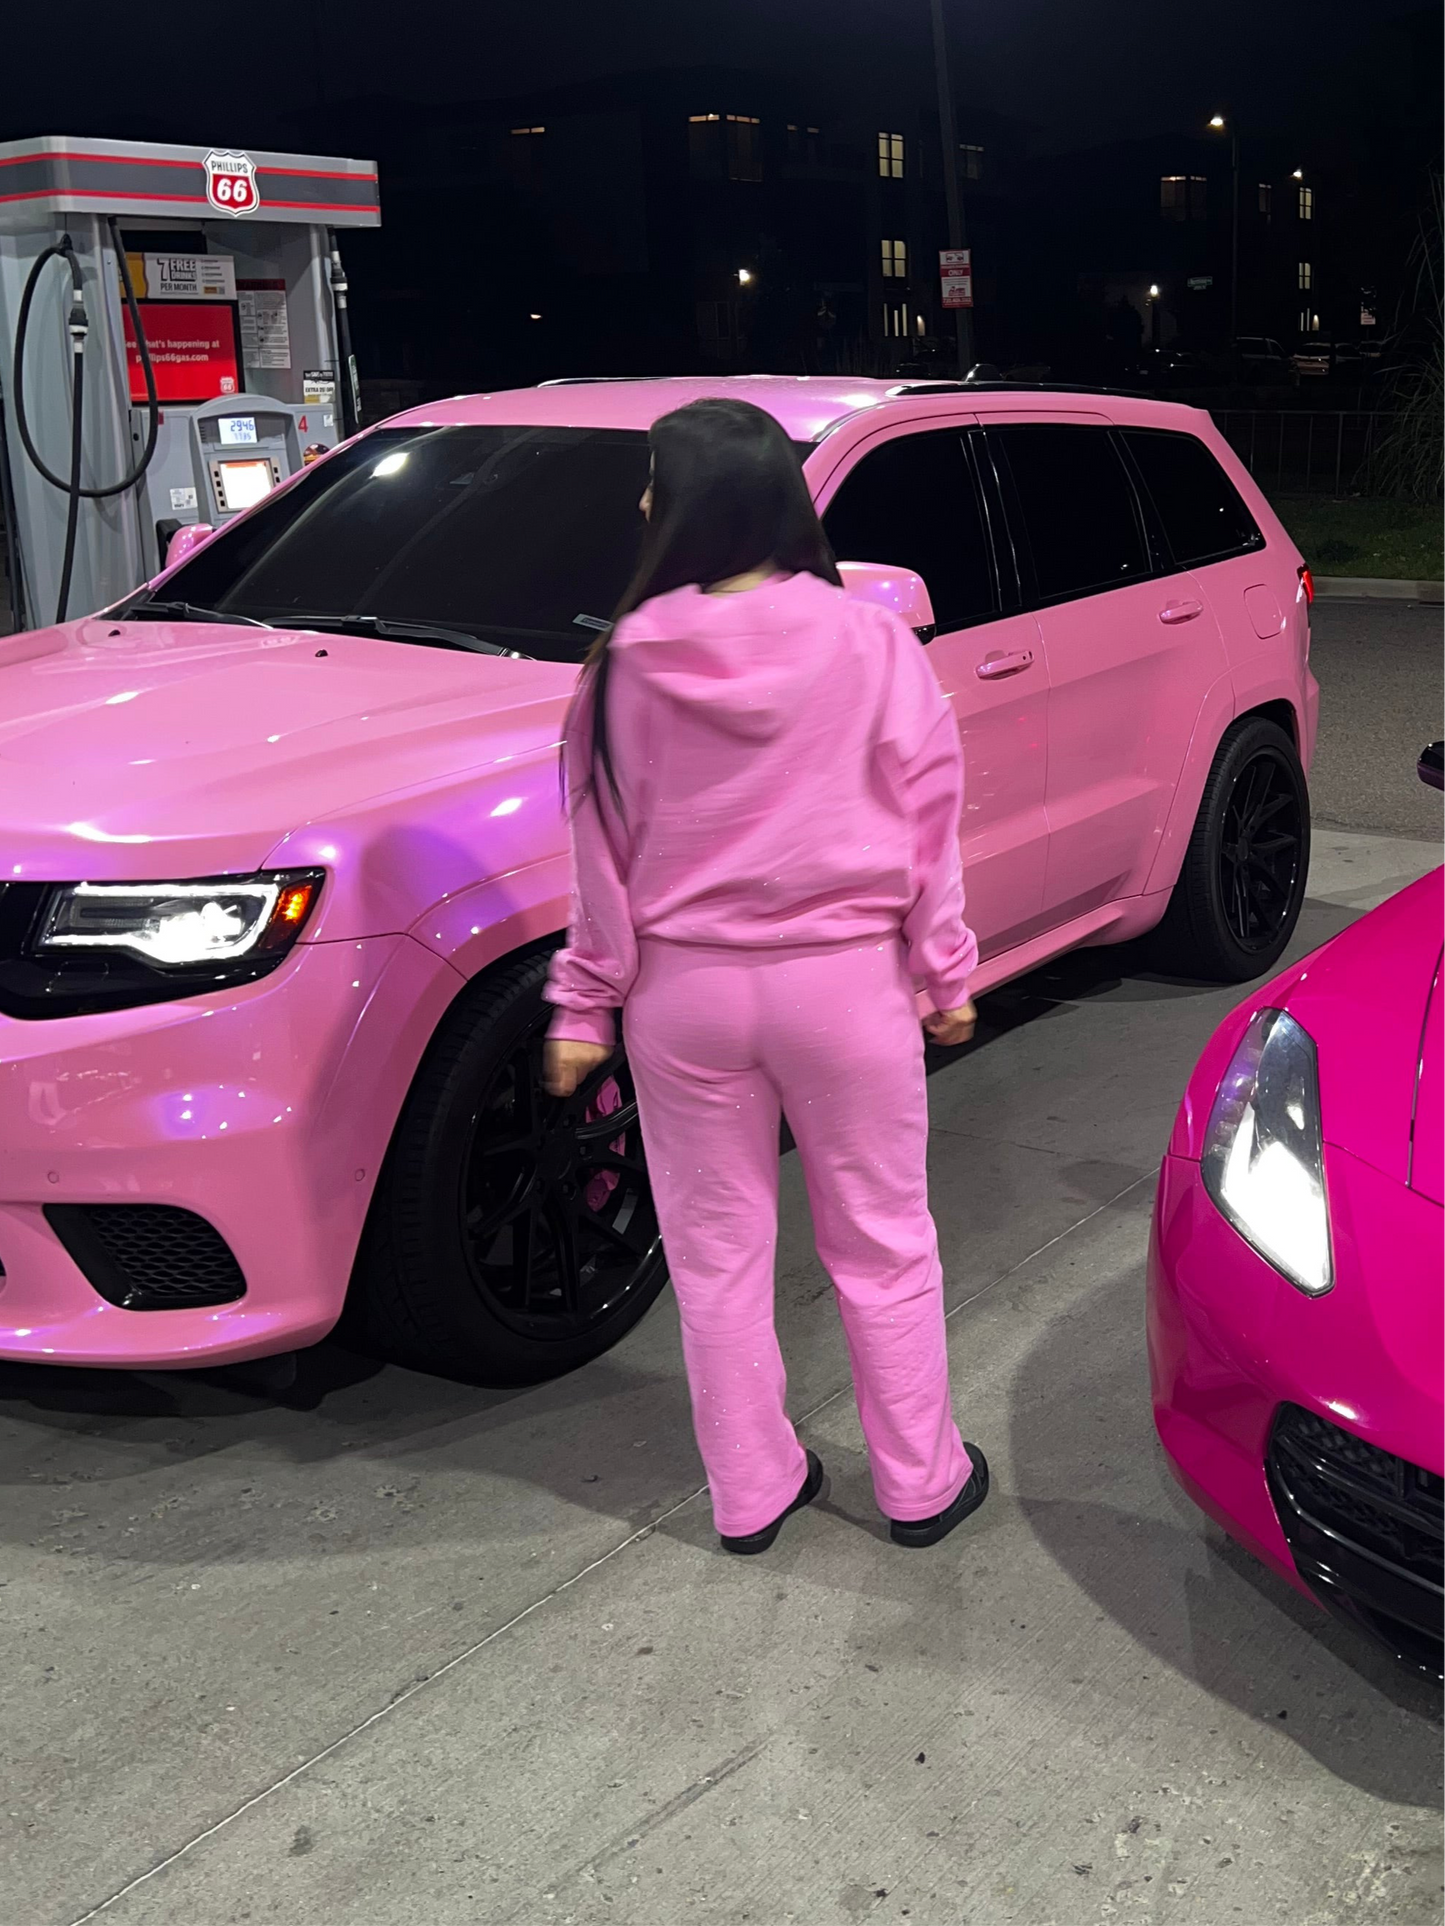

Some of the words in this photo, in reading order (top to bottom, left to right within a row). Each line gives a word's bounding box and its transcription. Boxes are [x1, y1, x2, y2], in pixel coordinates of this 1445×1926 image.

[211, 160, 249, 174] PHILLIPS
[217, 178, 248, 203] 66
[157, 258, 170, 281] 7
[171, 258, 196, 271] FREE
[160, 283, 173, 291] PER
[174, 283, 197, 292] MONTH
[124, 340, 137, 349] ee
[145, 339, 165, 349] hat's
[167, 339, 210, 350] happening
[212, 340, 220, 348] at
[230, 419, 255, 432] 2946
[298, 415, 308, 433] 4
